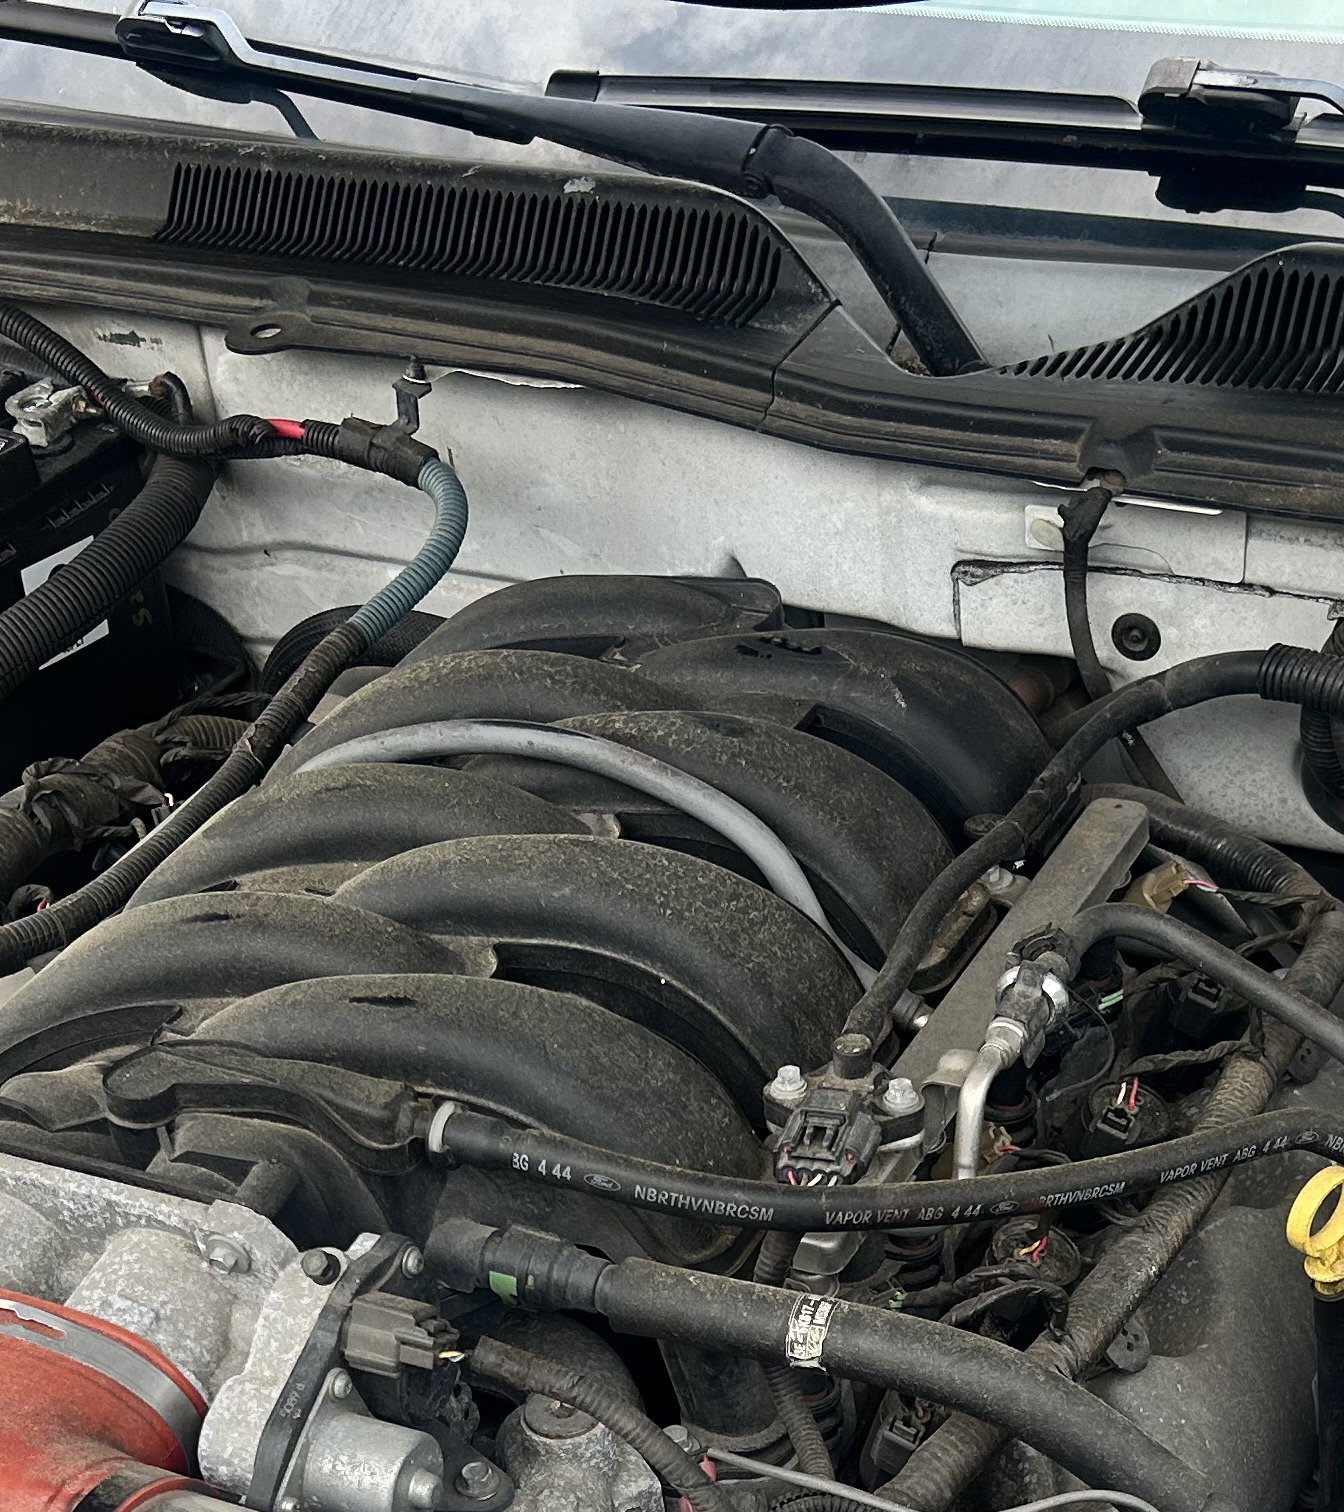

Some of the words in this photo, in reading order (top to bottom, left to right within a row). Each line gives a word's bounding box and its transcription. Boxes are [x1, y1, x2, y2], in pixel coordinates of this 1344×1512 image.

[1159, 1161, 1198, 1184] VAPOR
[1200, 1152, 1230, 1173] VENT
[1233, 1145, 1256, 1163] ABG
[1262, 1139, 1271, 1153] 4
[1273, 1136, 1288, 1150] 44
[538, 1158, 547, 1176] 4
[551, 1163, 572, 1182] 44
[587, 1174, 618, 1191] Ford
[634, 1184, 774, 1222] NBRTHVNBRCSM
[824, 1209, 872, 1225] VAPOR
[876, 1209, 909, 1225] VENT
[916, 1206, 944, 1221] ABG
[951, 1204, 961, 1219] 4
[964, 1203, 982, 1217] 44
